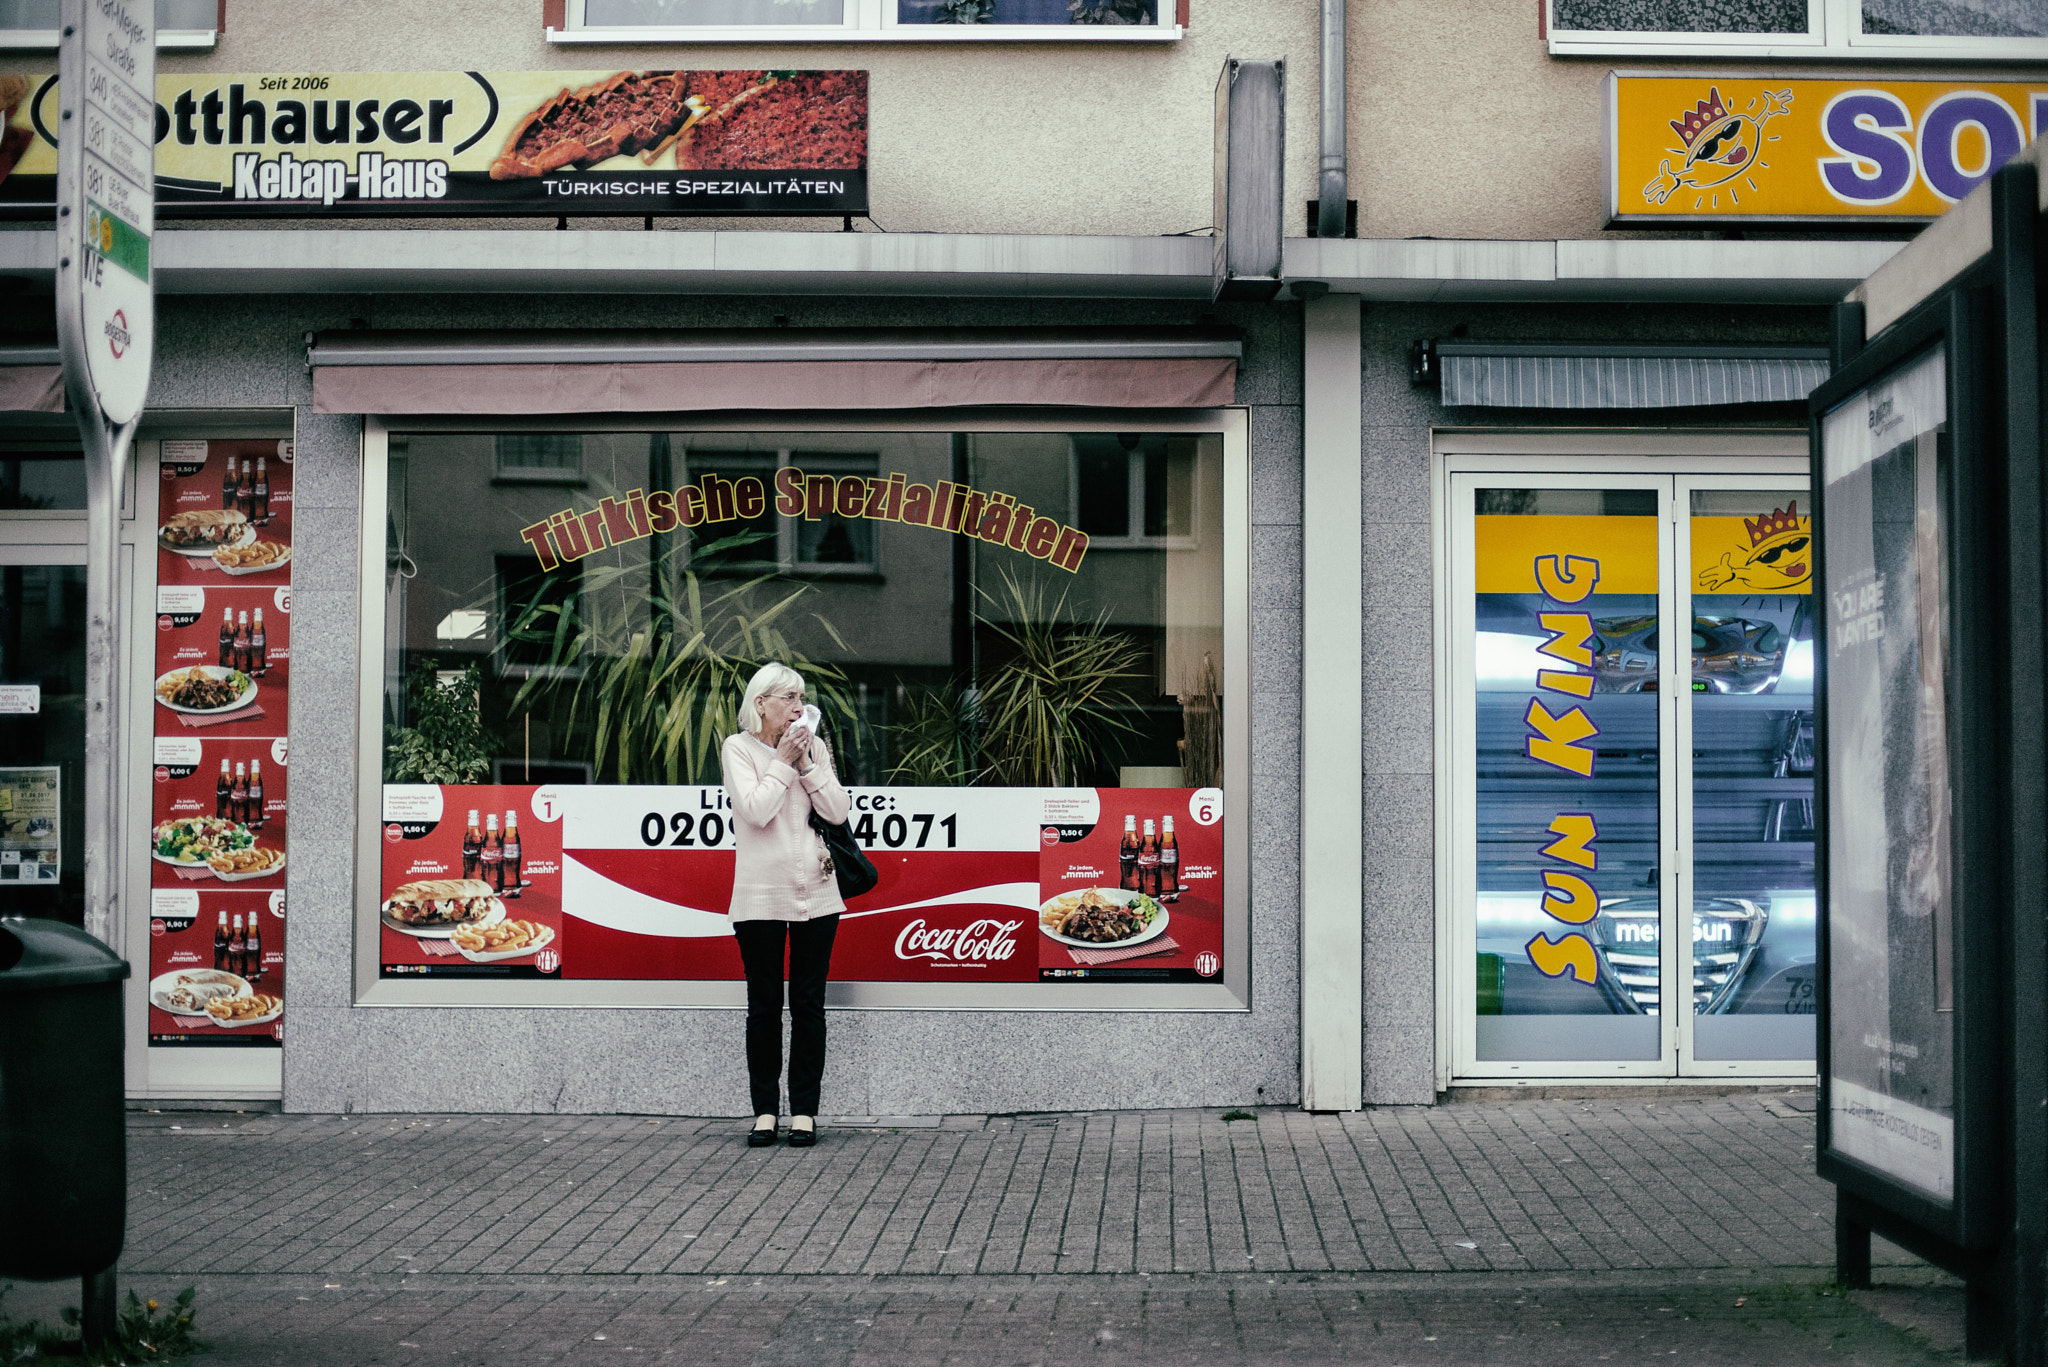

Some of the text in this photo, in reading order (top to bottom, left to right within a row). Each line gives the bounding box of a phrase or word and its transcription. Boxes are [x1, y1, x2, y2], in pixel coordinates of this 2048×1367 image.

[259, 77, 329, 91] Seit 2006
[1818, 88, 2048, 206] SO
[87, 164, 103, 197] 381
[234, 153, 448, 205] Kebap-Haus
[520, 467, 1090, 574] Türkische Spezialitäten
[1523, 554, 1600, 988] SUN KING
[543, 801, 551, 819] 1
[1200, 805, 1213, 822] 6
[894, 918, 1024, 960] Coca-Cola
